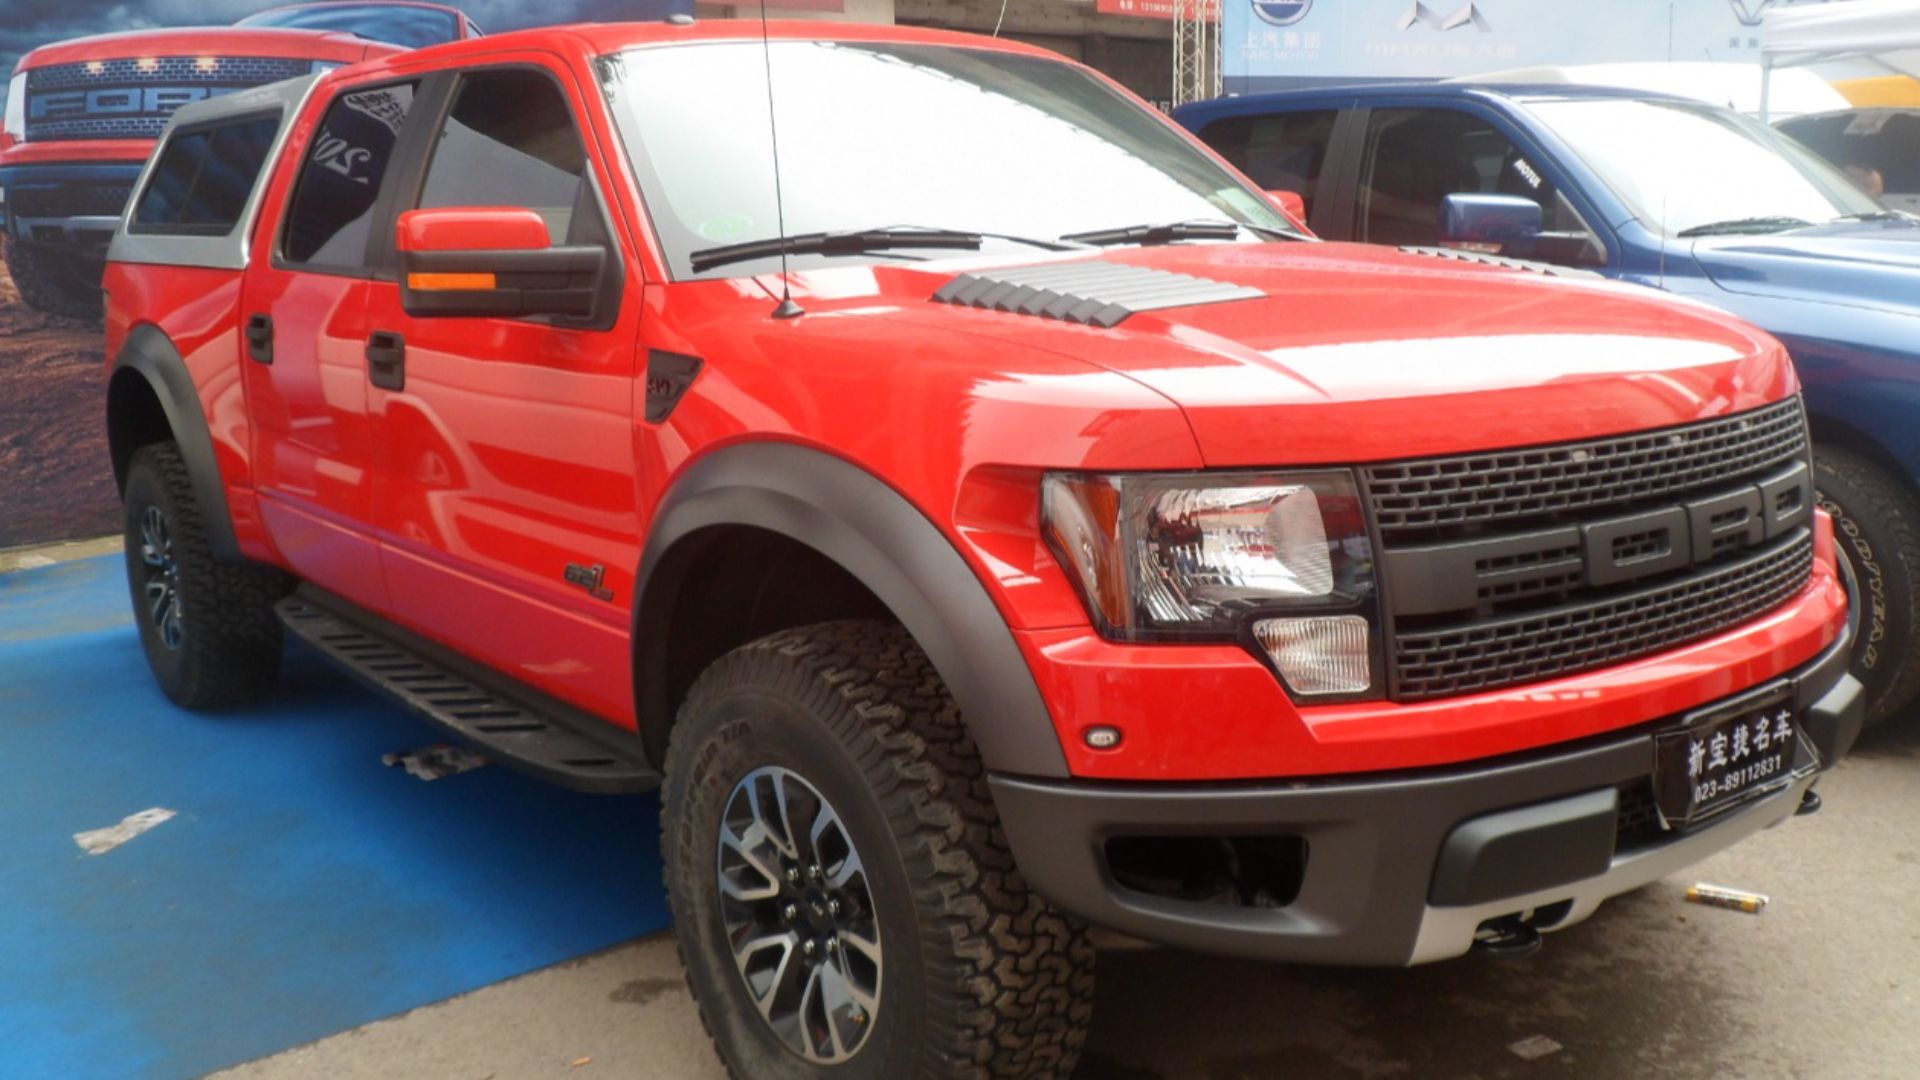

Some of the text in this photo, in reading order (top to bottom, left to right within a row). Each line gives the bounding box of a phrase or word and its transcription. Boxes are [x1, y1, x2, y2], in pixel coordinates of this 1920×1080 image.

[1240, 30, 1321, 49] 上汽集团
[1384, 461, 1811, 617] FORD
[1688, 709, 1793, 777] 新宝捷名车
[1695, 754, 1782, 803] 023-89112831
